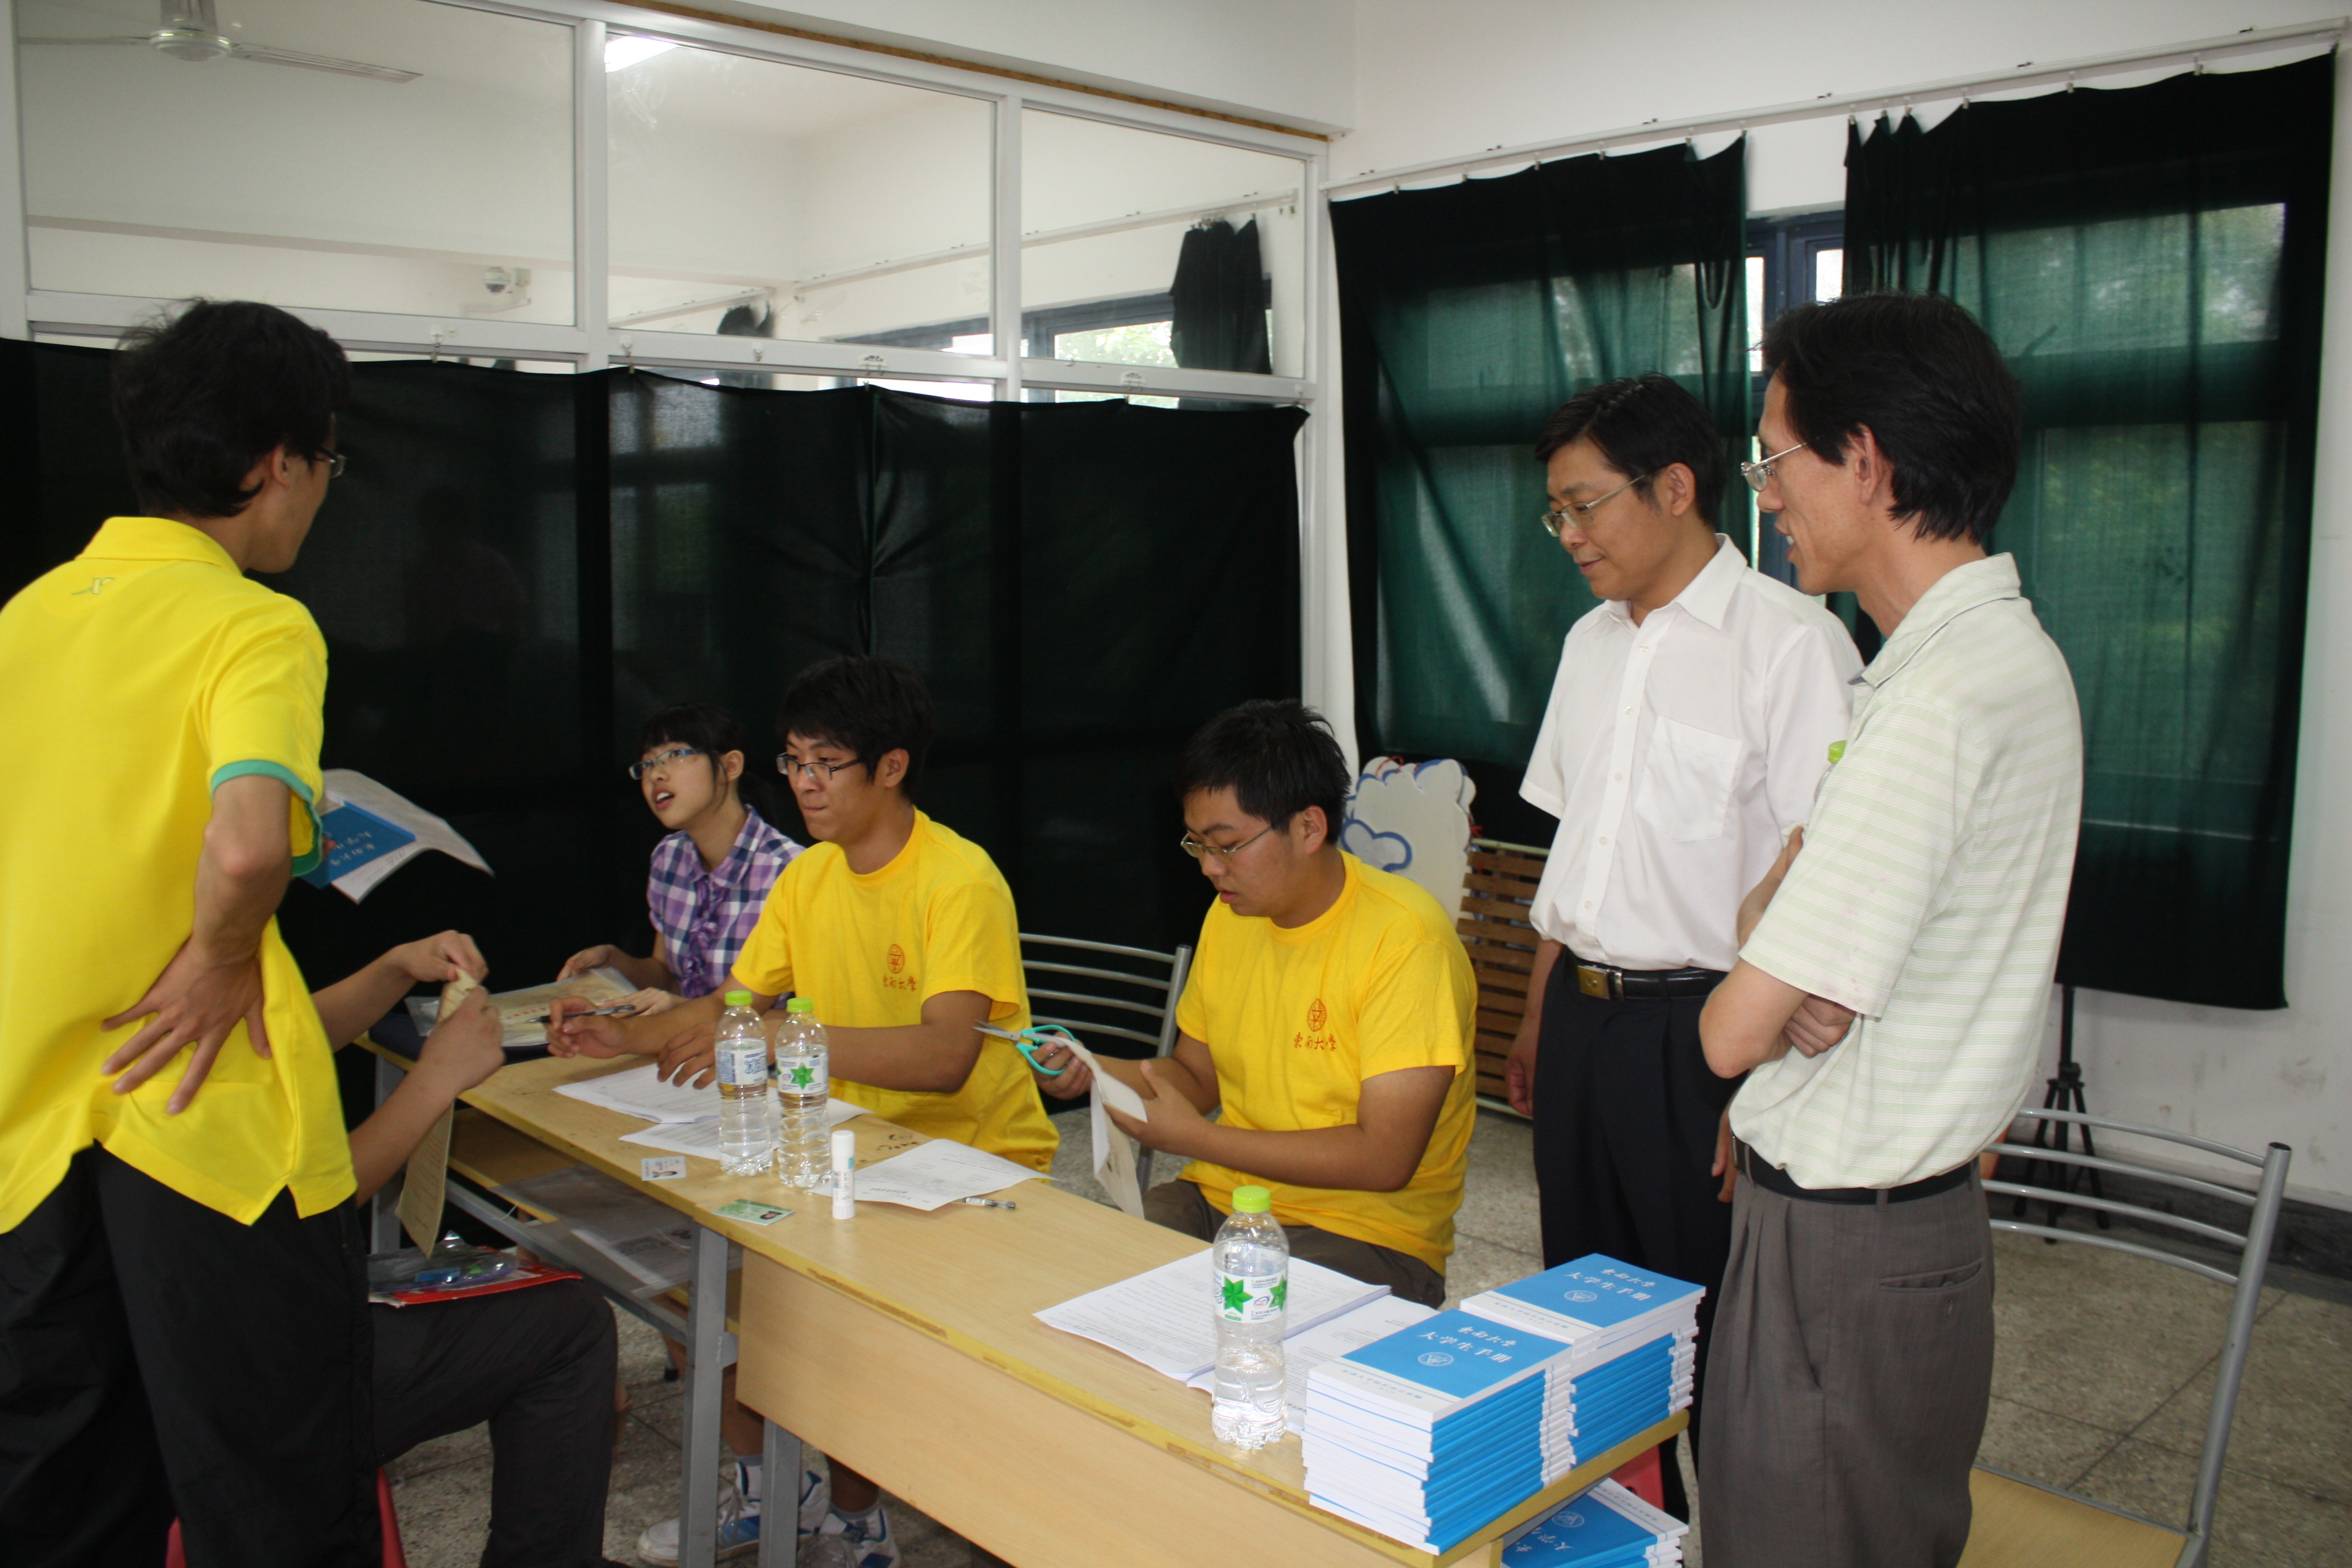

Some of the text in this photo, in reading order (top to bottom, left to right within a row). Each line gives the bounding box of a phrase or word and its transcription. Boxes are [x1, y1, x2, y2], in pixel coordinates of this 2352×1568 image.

[1417, 1331, 1513, 1364] 大学生手册
